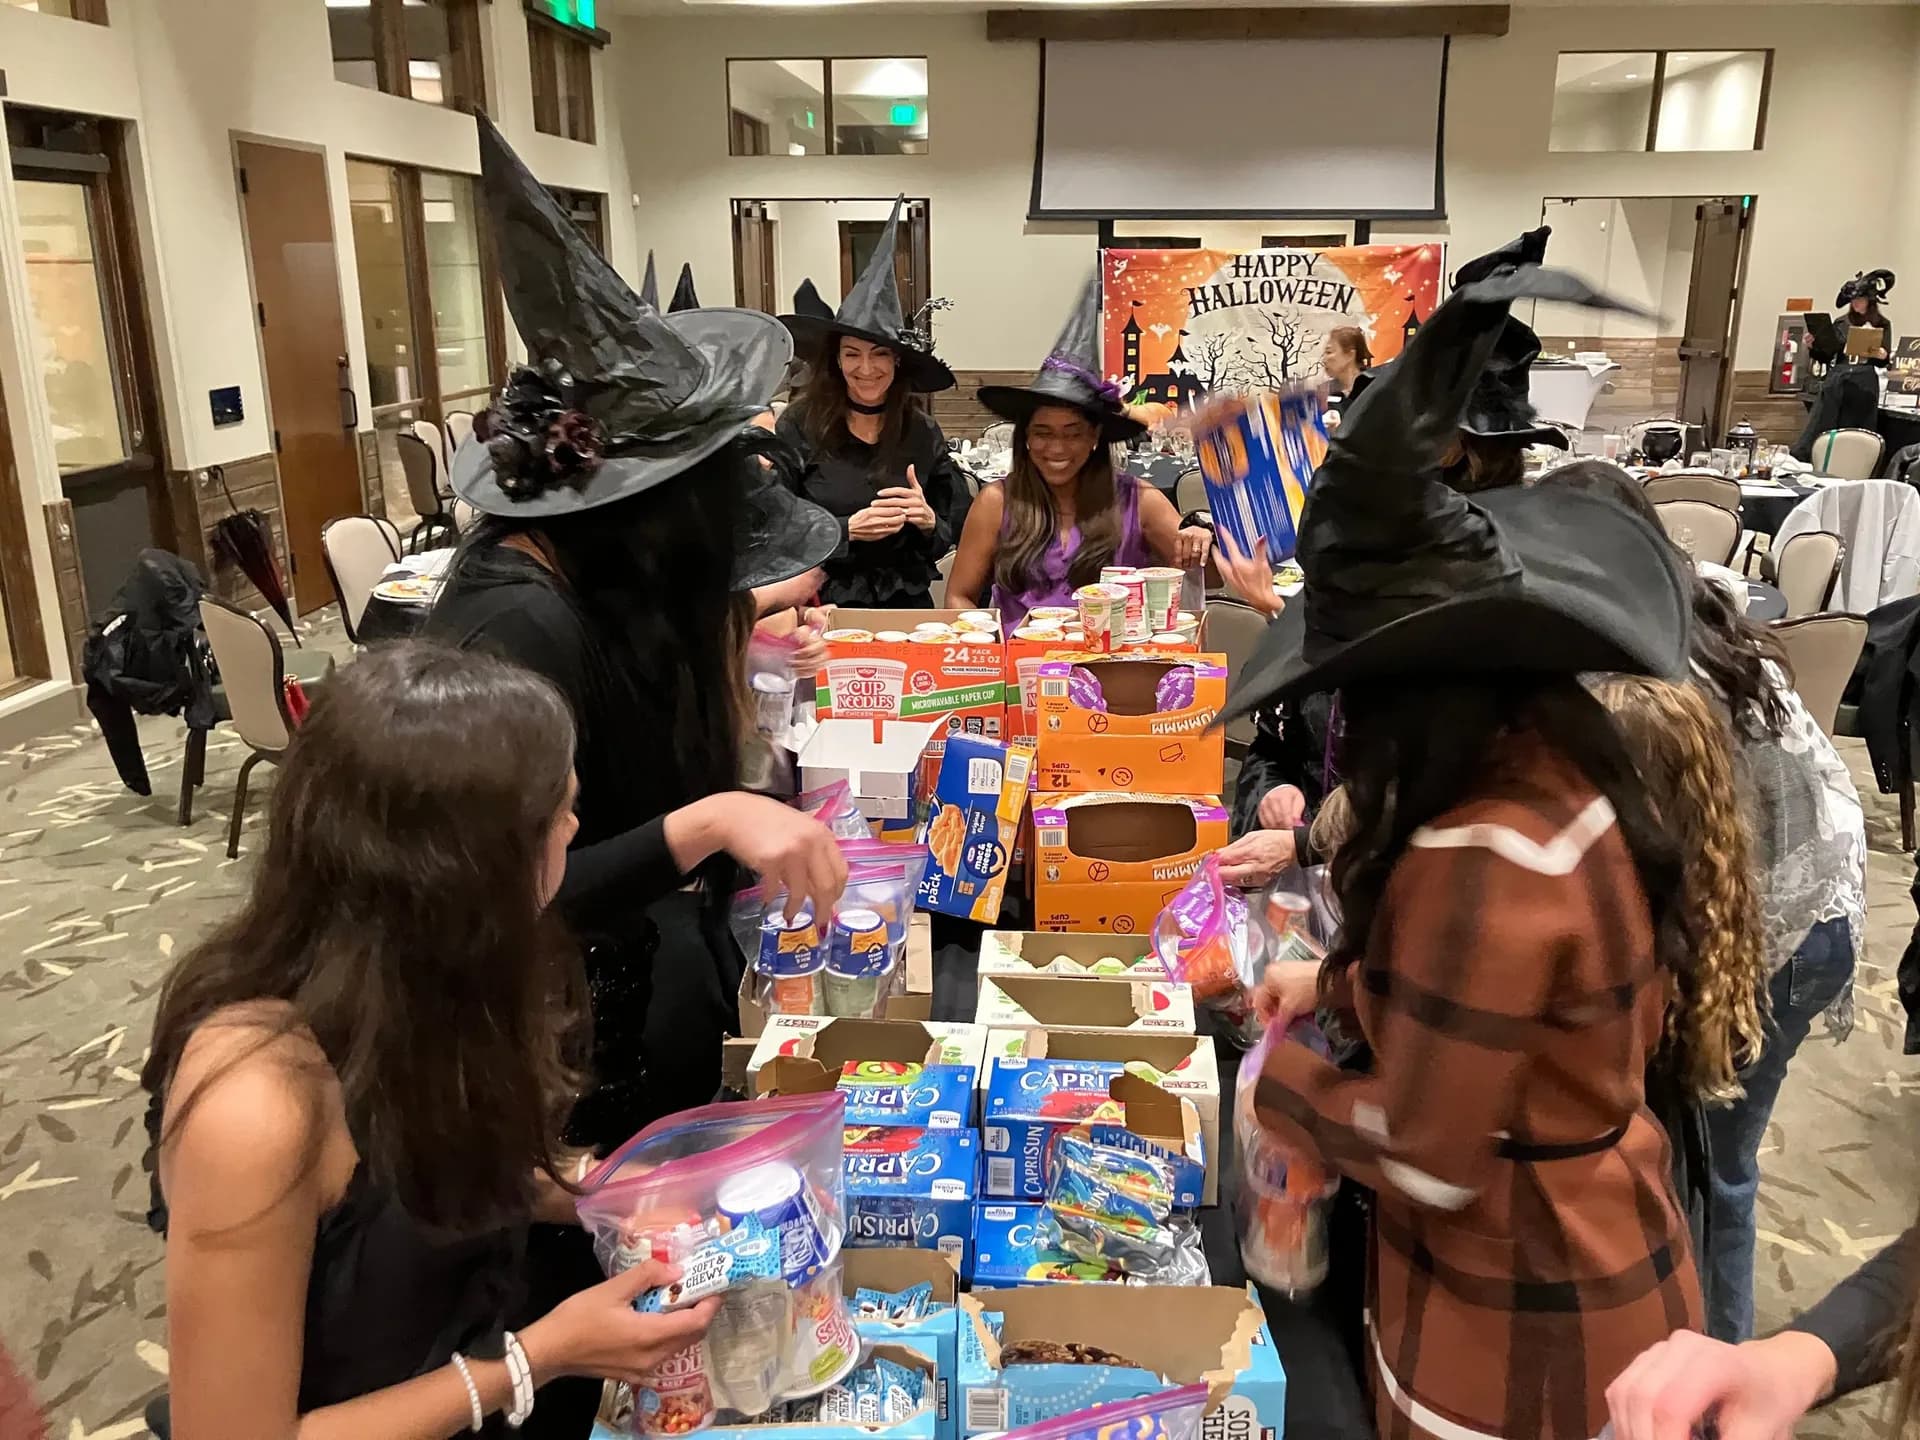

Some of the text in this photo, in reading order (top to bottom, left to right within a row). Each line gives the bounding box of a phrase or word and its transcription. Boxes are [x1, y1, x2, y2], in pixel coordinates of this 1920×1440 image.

[1232, 253, 1327, 279] HAPPY
[1181, 278, 1359, 319] HALLOWEEN
[943, 646, 970, 663] 24
[847, 680, 886, 695] CUP
[837, 694, 895, 709] NOODLES
[912, 689, 996, 710] MICROWAVABLE PAPER CUP
[1052, 774, 1071, 788] 12
[975, 849, 985, 870] mac
[918, 879, 931, 895] 12
[928, 872, 942, 904] pack
[1023, 1125, 1045, 1195] CAPRISUN
[692, 1255, 727, 1275] SOFT &
[686, 1265, 724, 1289] CHEWY
[839, 1390, 850, 1417] CHEWY
